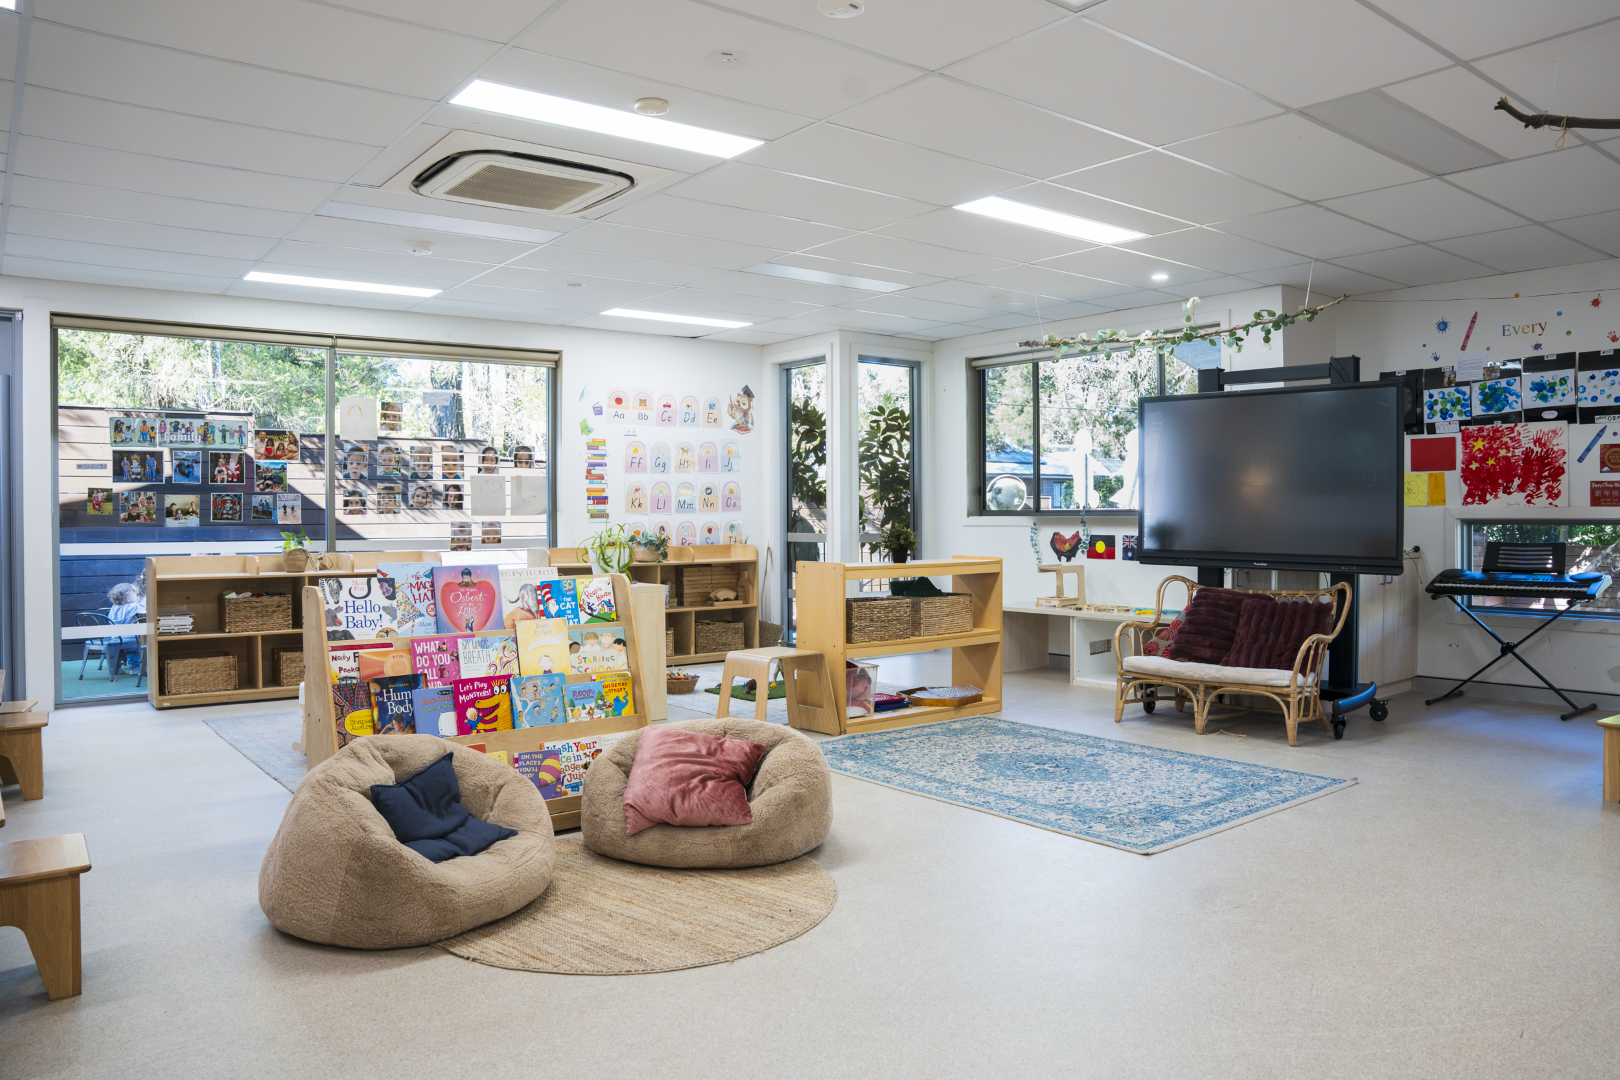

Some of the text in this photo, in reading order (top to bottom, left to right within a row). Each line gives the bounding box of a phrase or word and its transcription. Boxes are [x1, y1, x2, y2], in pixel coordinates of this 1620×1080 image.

[1501, 322, 1548, 337] Every
[613, 408, 718, 424] Aa Bb Cc Dd Ee
[630, 457, 643, 468] Ff
[655, 456, 667, 473] Gg
[679, 458, 691, 470] Hh
[724, 456, 734, 472] Jj
[630, 496, 737, 510] Kk Ll Mm Nn Oo
[412, 589, 435, 604] HAT
[450, 591, 488, 603] Osbert
[345, 600, 381, 614] Hello
[455, 602, 482, 618] Love
[560, 602, 576, 610] CAT
[345, 614, 383, 631] Baby!
[567, 618, 579, 626] AT
[414, 641, 440, 654] WHAT
[461, 640, 470, 650] MY
[416, 653, 450, 668] DO YOU
[462, 649, 491, 665] BREATH
[577, 655, 615, 665] STARTING
[338, 666, 360, 674] Peeka
[459, 683, 473, 693] Let's
[474, 681, 488, 690] Play
[382, 688, 412, 702] Hum
[458, 688, 492, 704] MONSTERS!
[387, 699, 414, 717] Body
[349, 718, 373, 726] Shape
[350, 724, 373, 732] Austra
[572, 740, 598, 753] Your
[560, 753, 583, 765] ce in
[560, 763, 581, 775] ange
[566, 771, 587, 783] Juic
